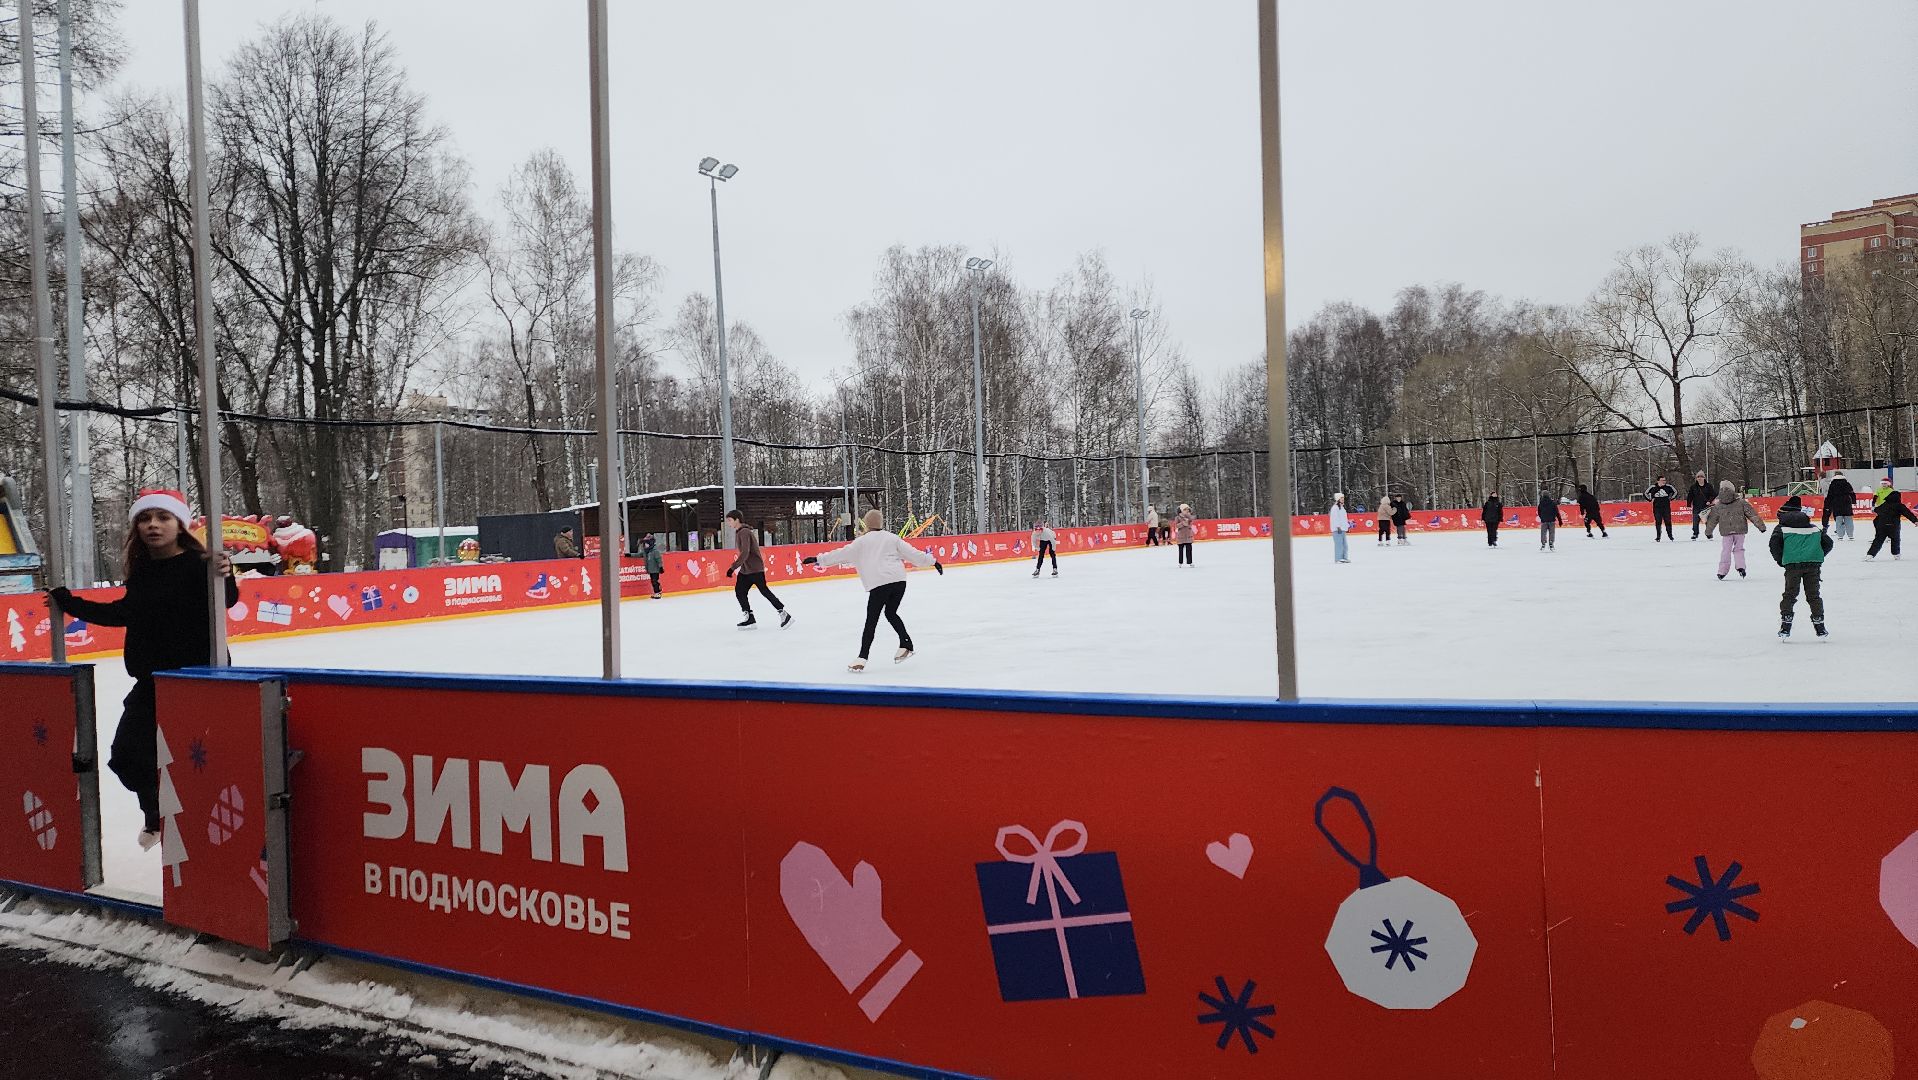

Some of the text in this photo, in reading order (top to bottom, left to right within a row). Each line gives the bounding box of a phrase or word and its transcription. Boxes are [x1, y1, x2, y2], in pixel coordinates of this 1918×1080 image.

[796, 501, 824, 515] КАФЕ
[444, 575, 502, 596] ЗИМА
[361, 747, 629, 873] ЗИМА
[364, 862, 631, 940] В ПОДМОСКОВЬЕ
